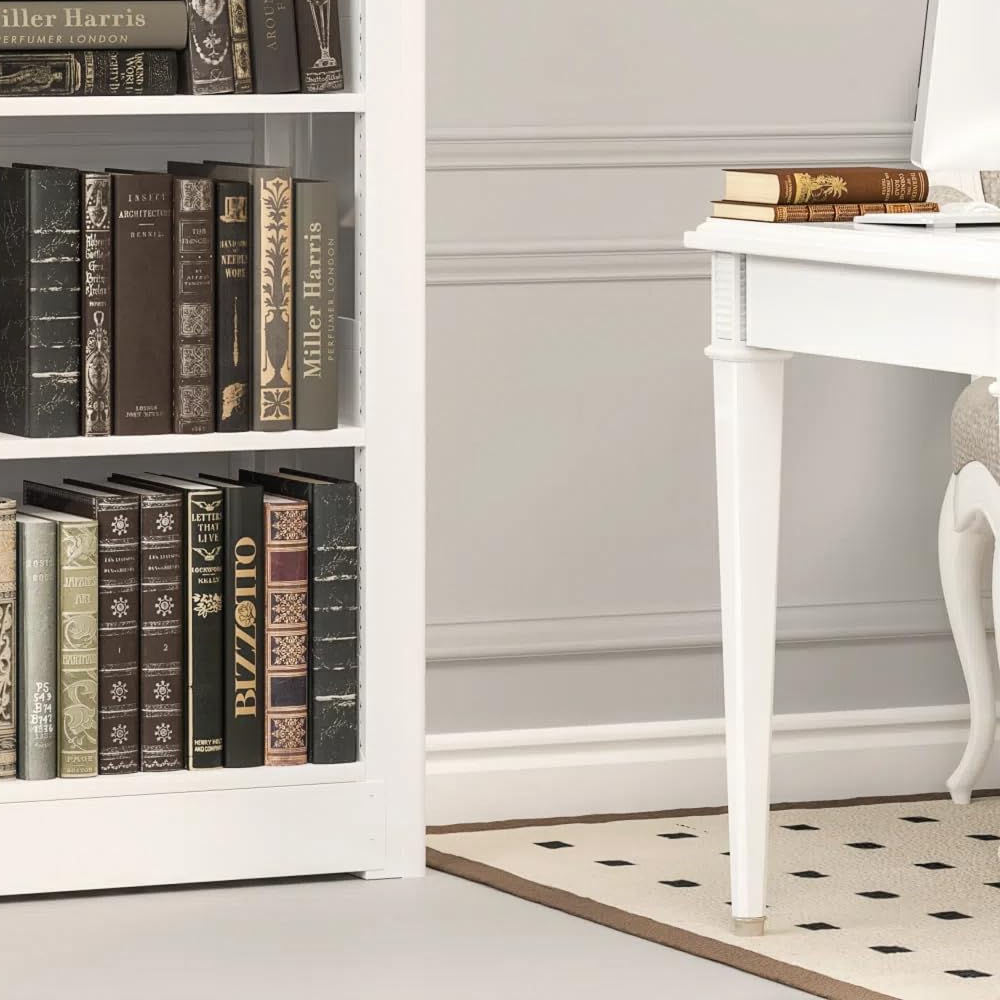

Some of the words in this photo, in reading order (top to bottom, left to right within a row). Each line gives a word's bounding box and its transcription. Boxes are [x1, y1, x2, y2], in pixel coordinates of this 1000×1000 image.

[64, 8, 146, 28] Harris
[70, 34, 129, 44] LONDON
[128, 193, 165, 202] INSECT
[304, 222, 322, 299] Harris
[303, 304, 321, 379] Miller
[198, 523, 219, 532] THAT
[198, 534, 219, 543] LIVE
[163, 643, 168, 652] 2
[36, 682, 49, 693] PS
